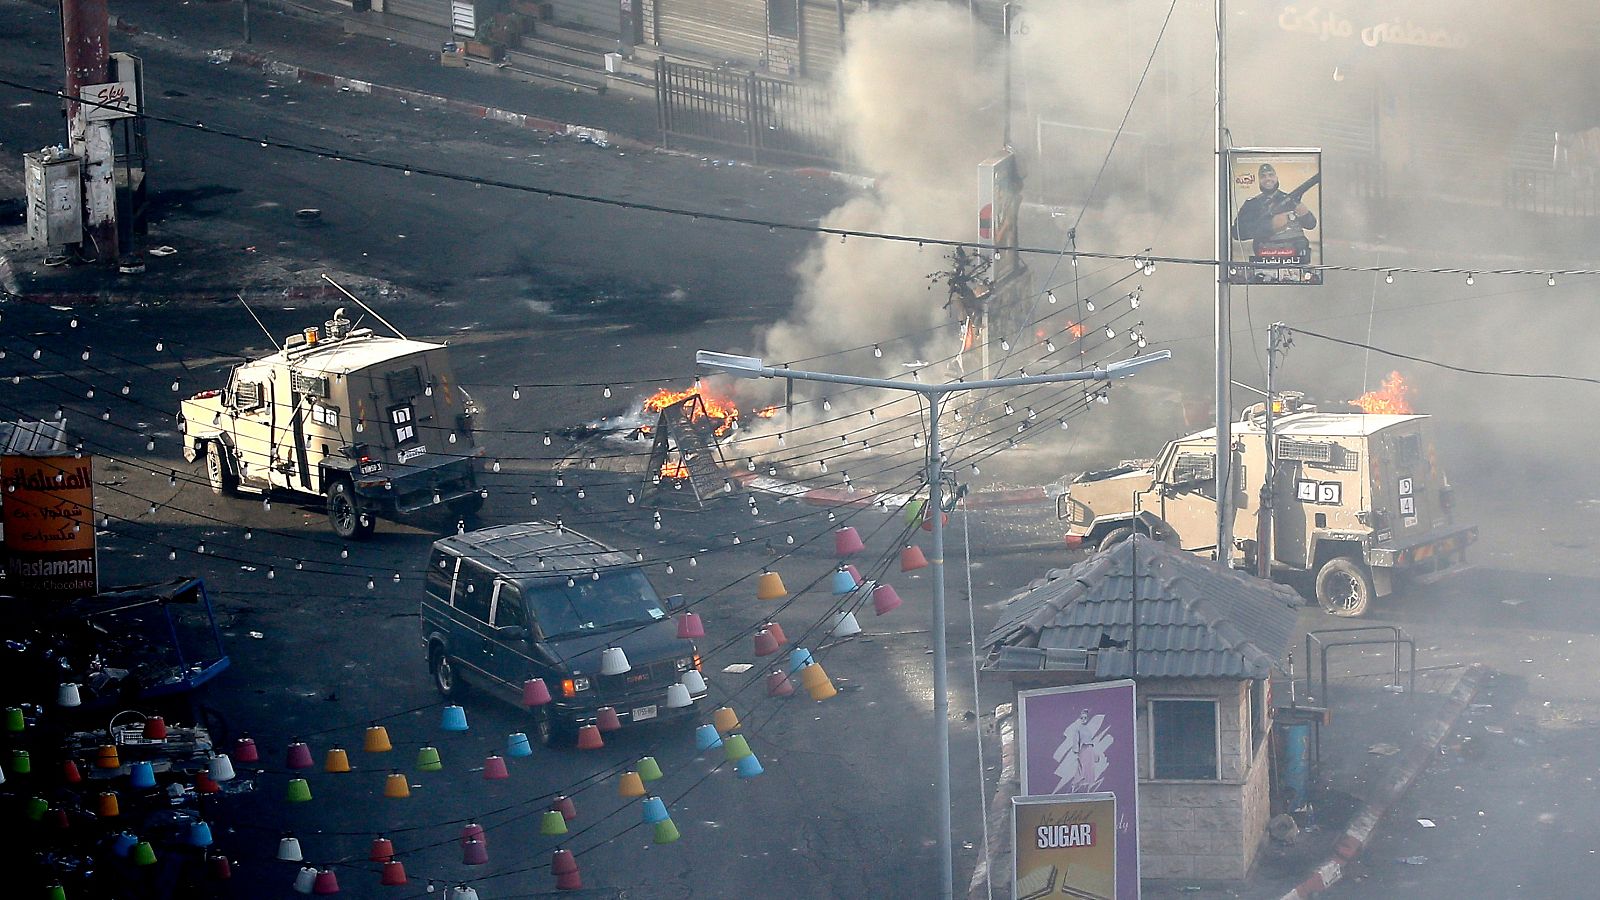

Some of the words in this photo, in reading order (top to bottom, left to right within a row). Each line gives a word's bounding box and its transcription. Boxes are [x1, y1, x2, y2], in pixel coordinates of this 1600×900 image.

[1278, 6, 1353, 41] ماركت
[97, 85, 126, 107] Sky
[8, 556, 94, 577] Maslamani
[43, 578, 95, 591] Chocolate
[1036, 823, 1091, 848] SUGAR
